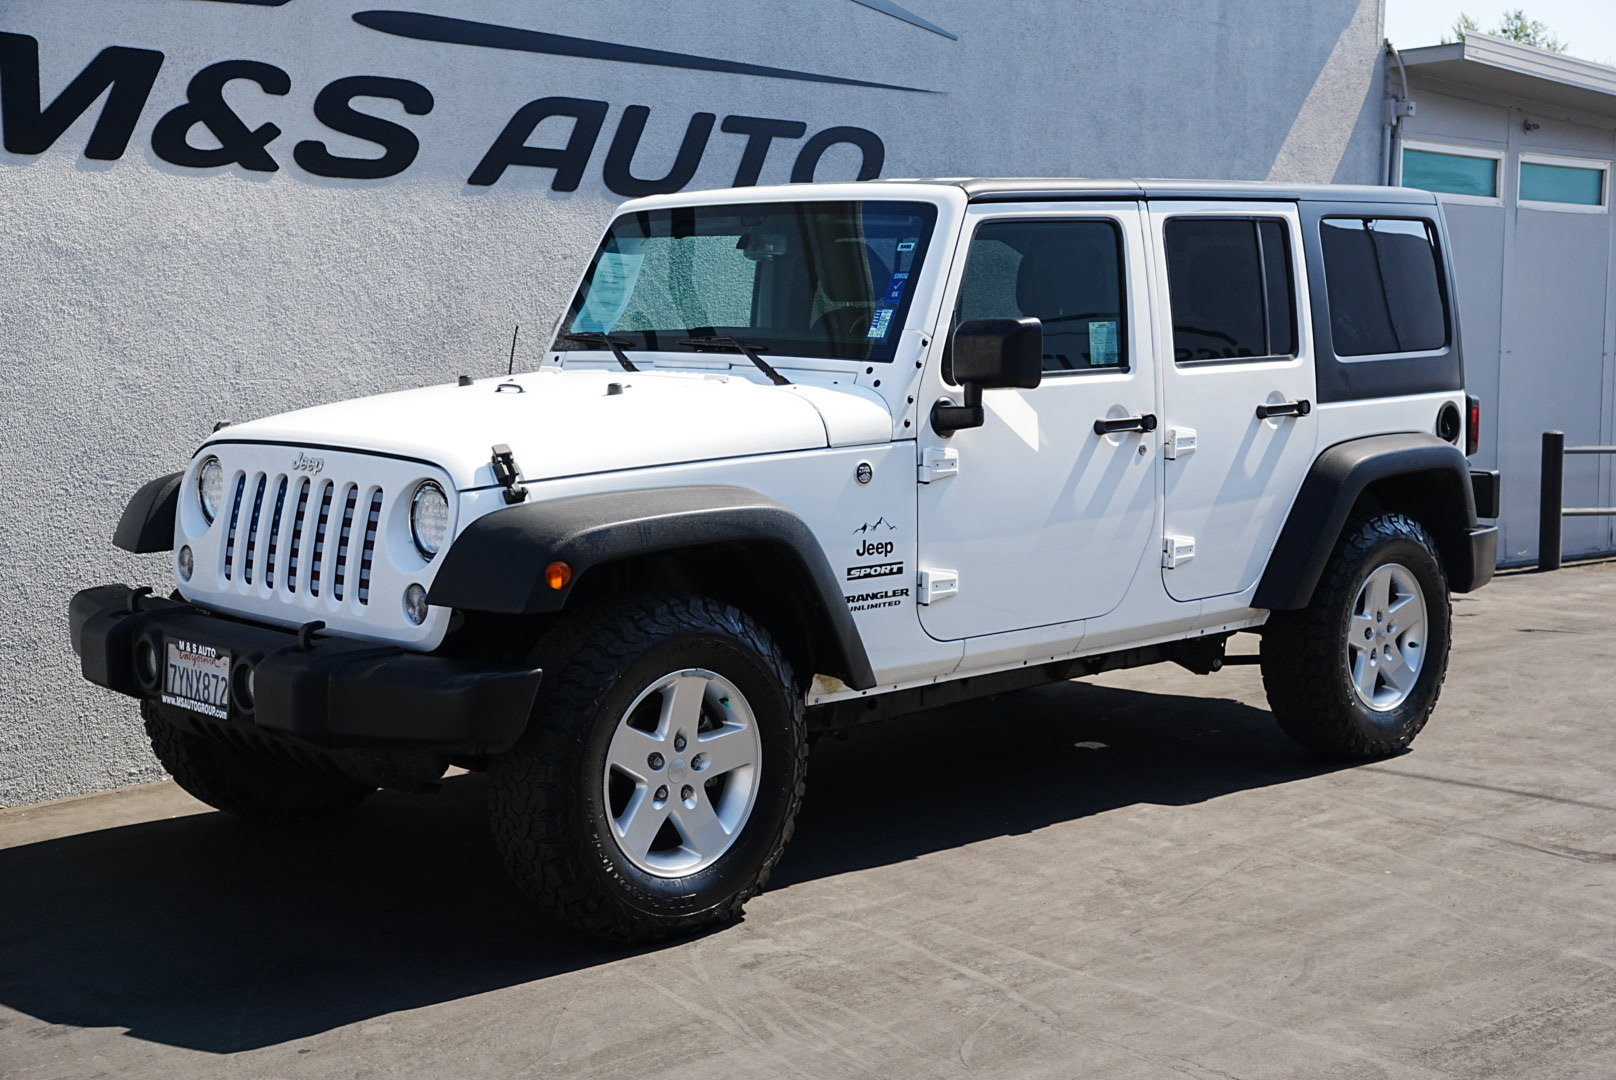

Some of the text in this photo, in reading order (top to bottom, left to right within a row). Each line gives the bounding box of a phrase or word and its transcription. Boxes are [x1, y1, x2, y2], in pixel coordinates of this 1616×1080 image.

[0, 31, 886, 198] M&S AUTO
[292, 451, 325, 476] Jeep
[856, 539, 894, 557] Jeep
[850, 565, 901, 578] SPORT
[844, 587, 910, 604] RANGLER
[179, 641, 217, 658] M & S AUTO
[169, 664, 228, 708] 7YNX872
